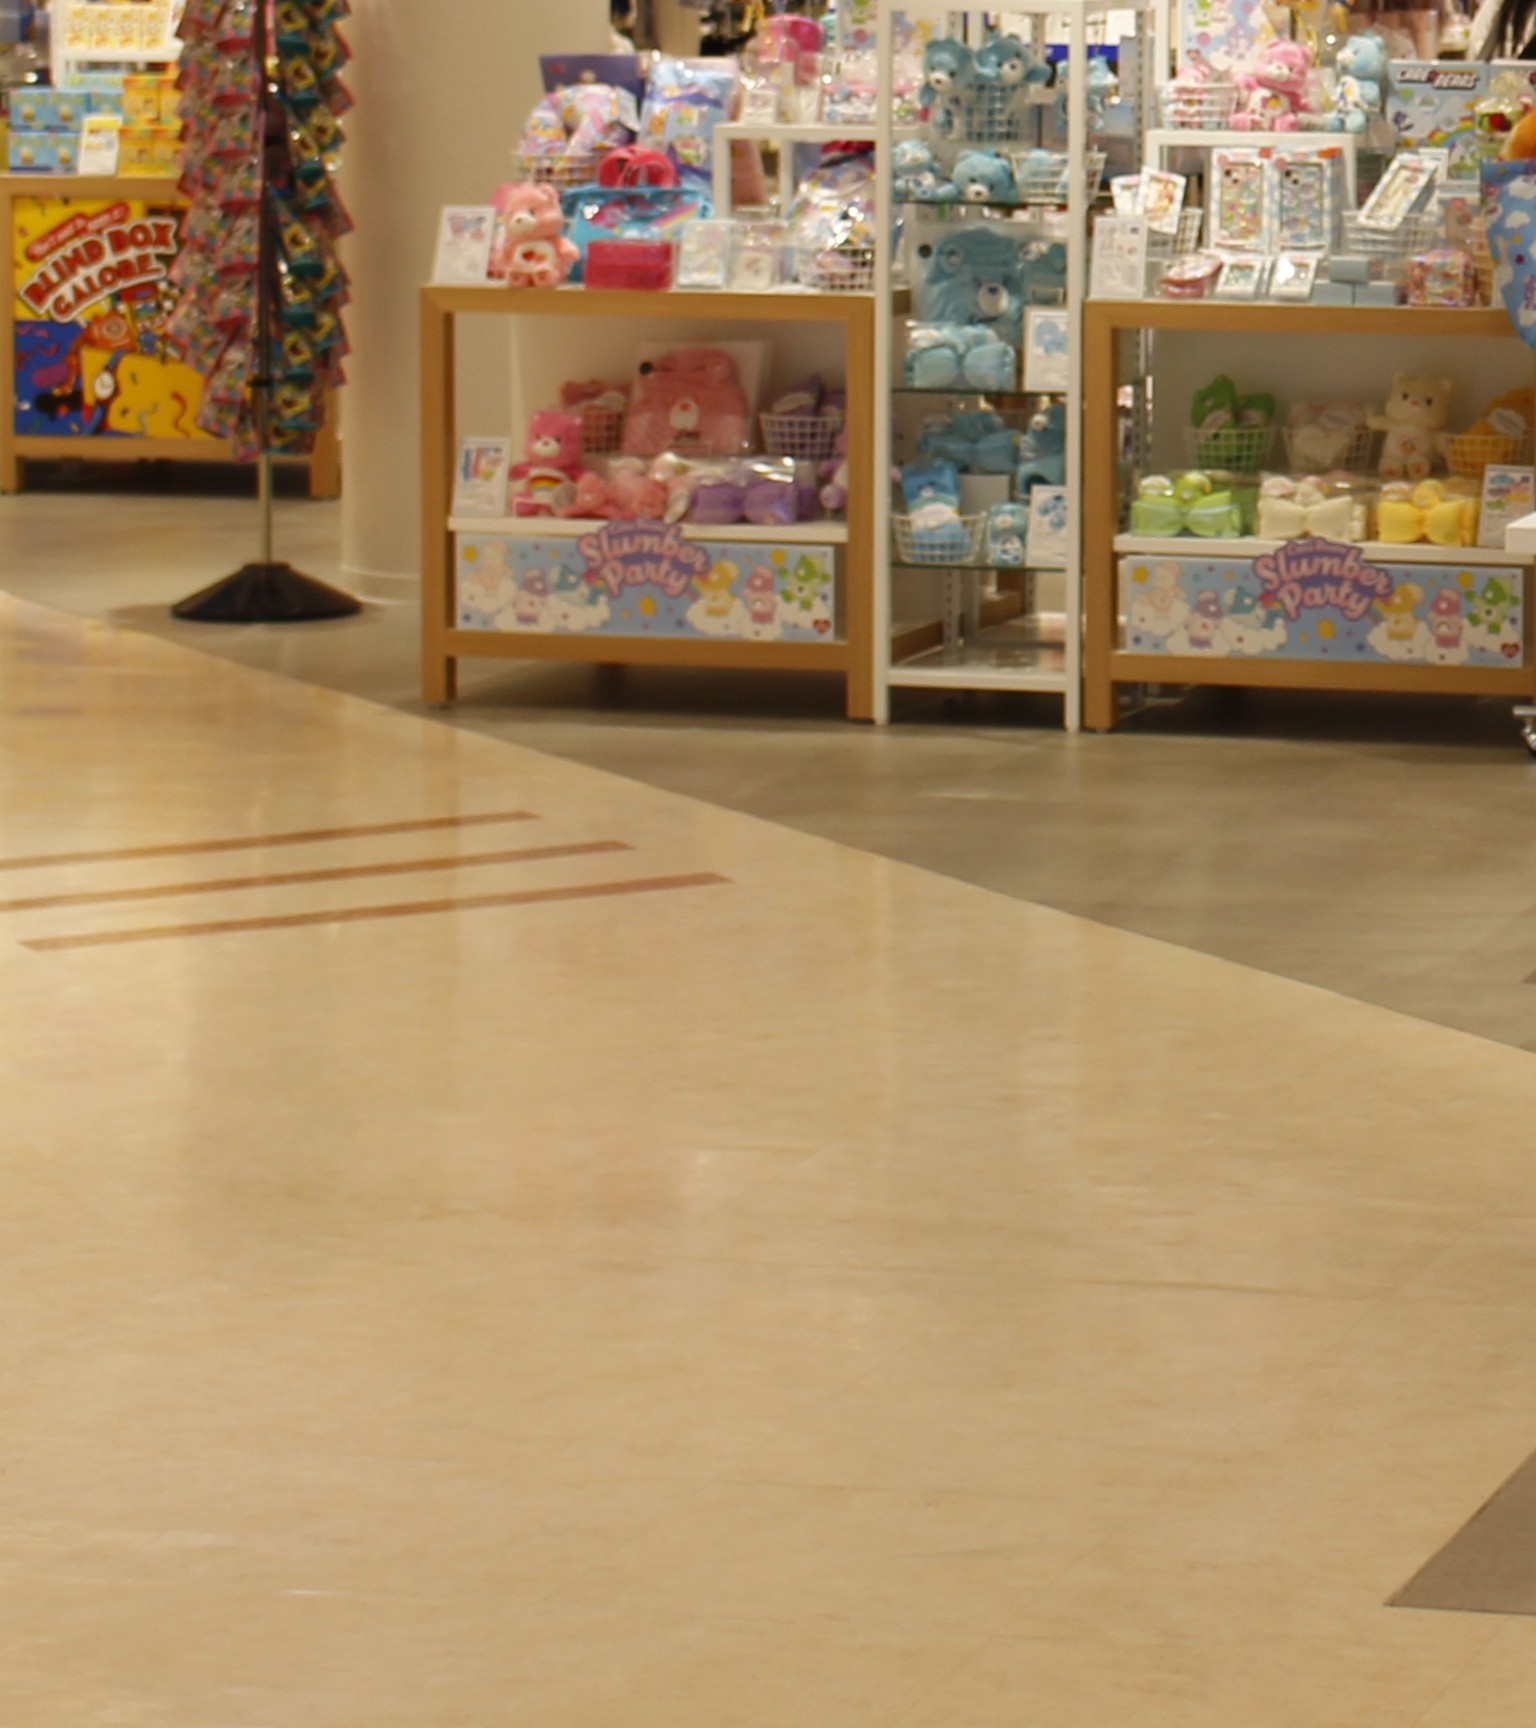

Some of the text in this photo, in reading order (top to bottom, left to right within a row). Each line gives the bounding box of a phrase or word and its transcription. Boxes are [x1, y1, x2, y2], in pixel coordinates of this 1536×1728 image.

[24, 239, 106, 307] BLIND
[107, 222, 174, 254] BOX
[577, 523, 709, 573] Slumber
[1253, 546, 1393, 595] Slumber
[599, 558, 690, 597] Party
[1277, 580, 1371, 621] Party
